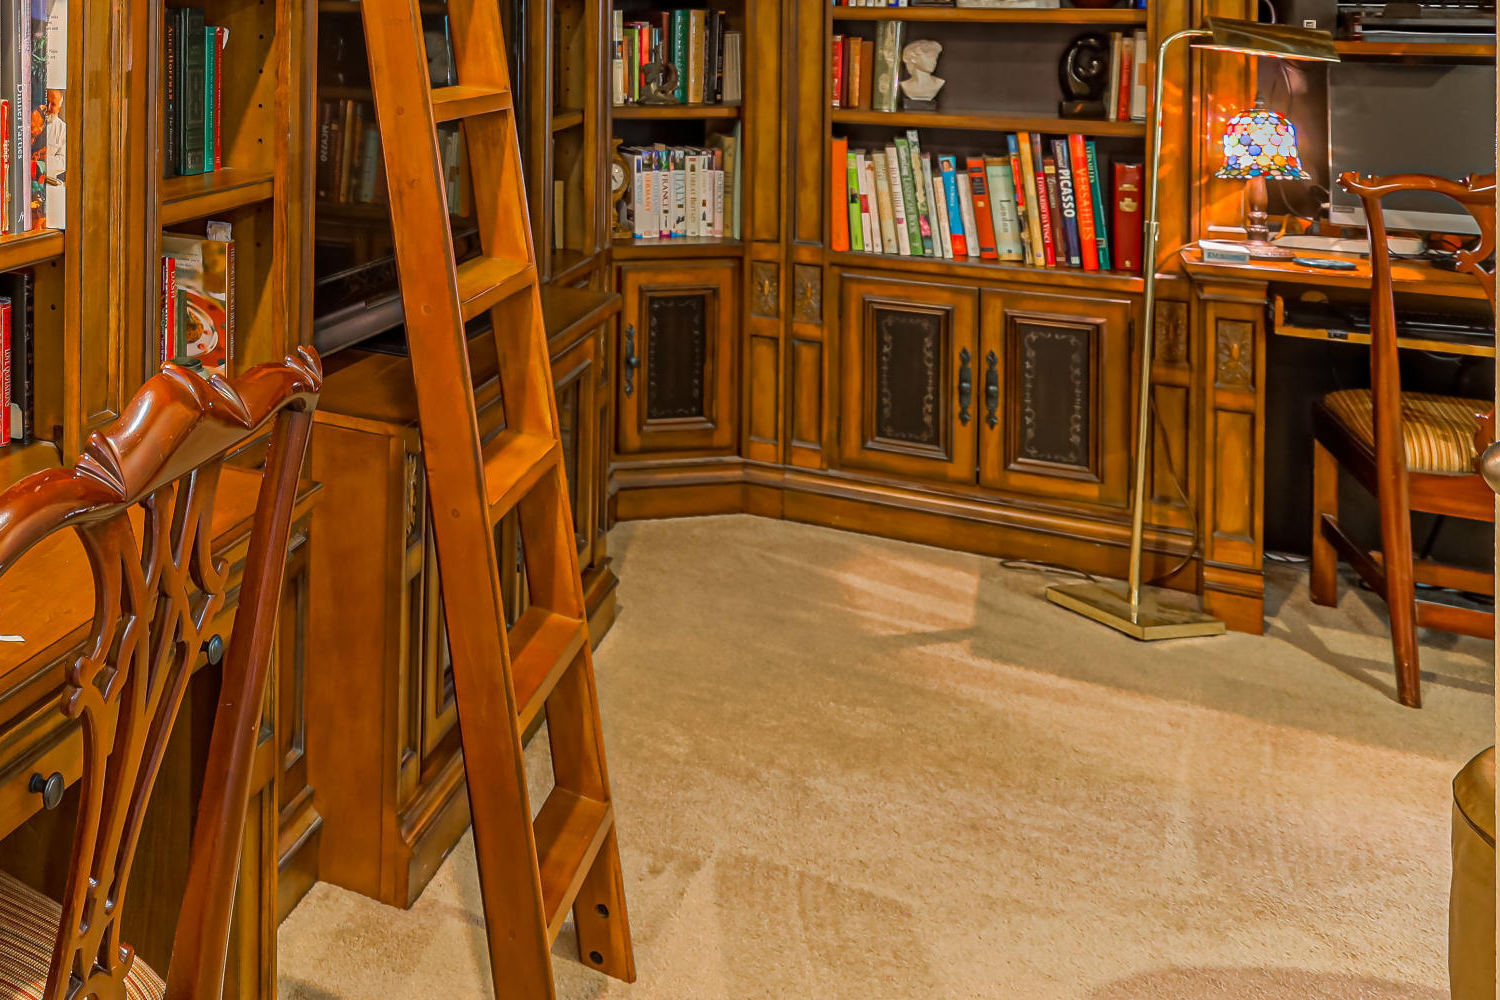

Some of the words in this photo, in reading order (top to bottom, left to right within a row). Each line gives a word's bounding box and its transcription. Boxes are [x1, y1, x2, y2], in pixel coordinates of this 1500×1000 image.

[643, 173, 652, 213] GERMANY
[675, 172, 685, 203] ITALY
[1036, 176, 1048, 213] LEONARDO
[1042, 223, 1051, 244] VINCI
[1058, 168, 1076, 218] PICASSO
[1075, 168, 1094, 241] VERSAILLES
